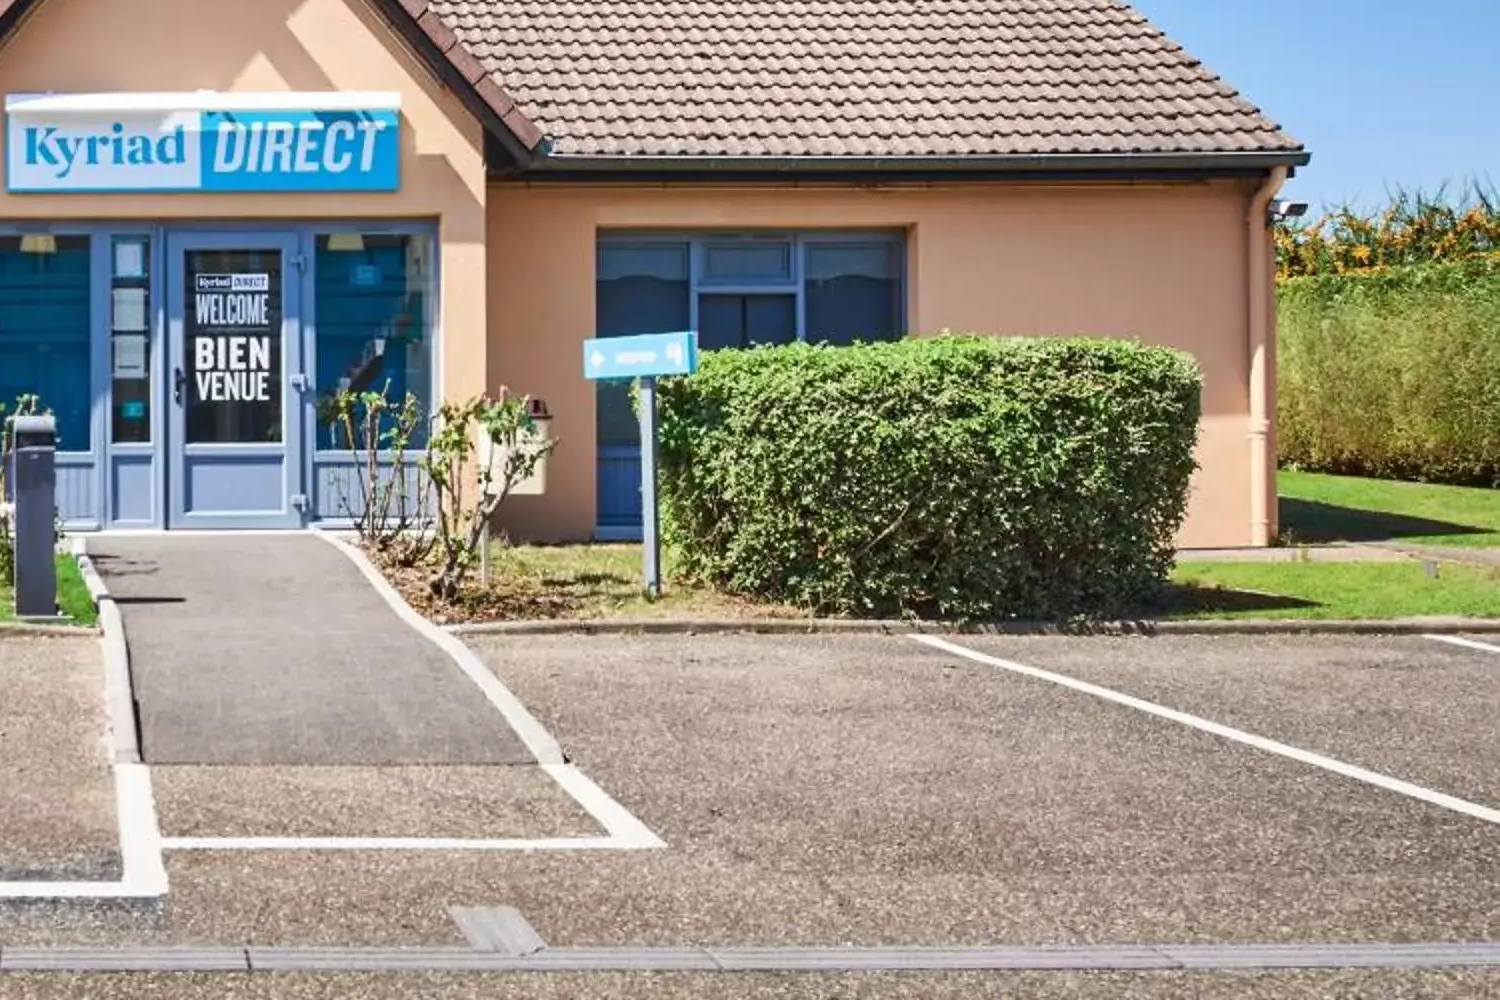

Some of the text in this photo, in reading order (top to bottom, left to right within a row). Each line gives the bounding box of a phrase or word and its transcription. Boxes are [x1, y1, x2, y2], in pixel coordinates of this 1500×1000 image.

[25, 119, 387, 178] Kyriad DIRECT
[196, 293, 269, 325] WELCOME
[196, 336, 270, 370] BIEN
[196, 371, 270, 401] VENUE
